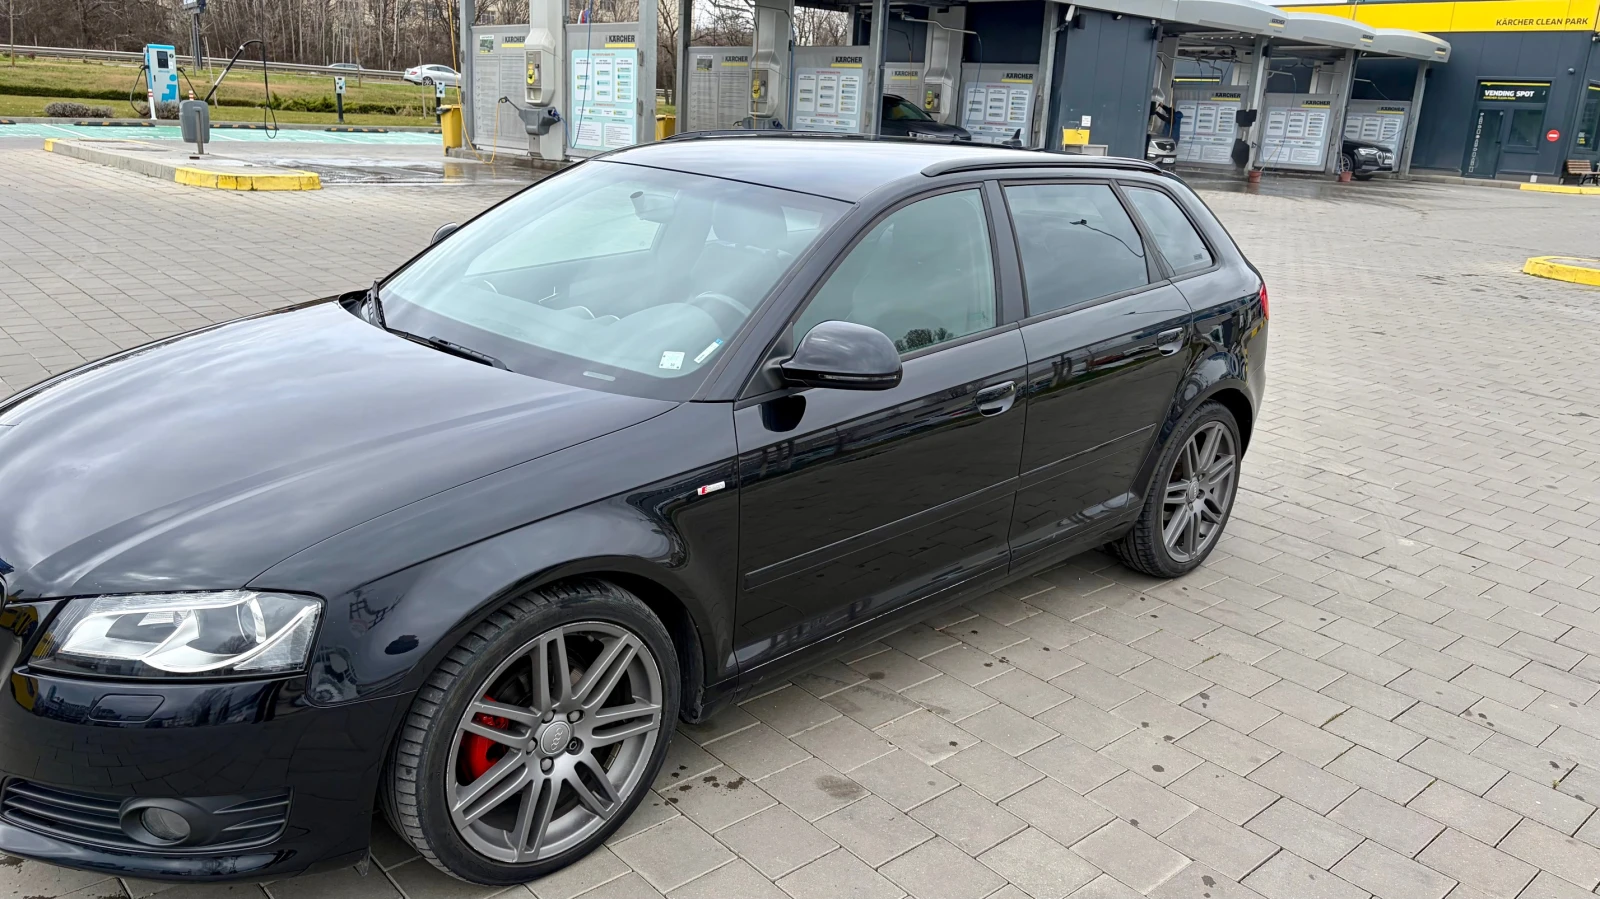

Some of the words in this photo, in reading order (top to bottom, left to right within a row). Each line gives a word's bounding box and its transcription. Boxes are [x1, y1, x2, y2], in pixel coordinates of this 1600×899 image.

[1496, 18, 1534, 26] KÄRCHER
[1565, 17, 1588, 25] PARK
[608, 35, 635, 43] KÄRCHER
